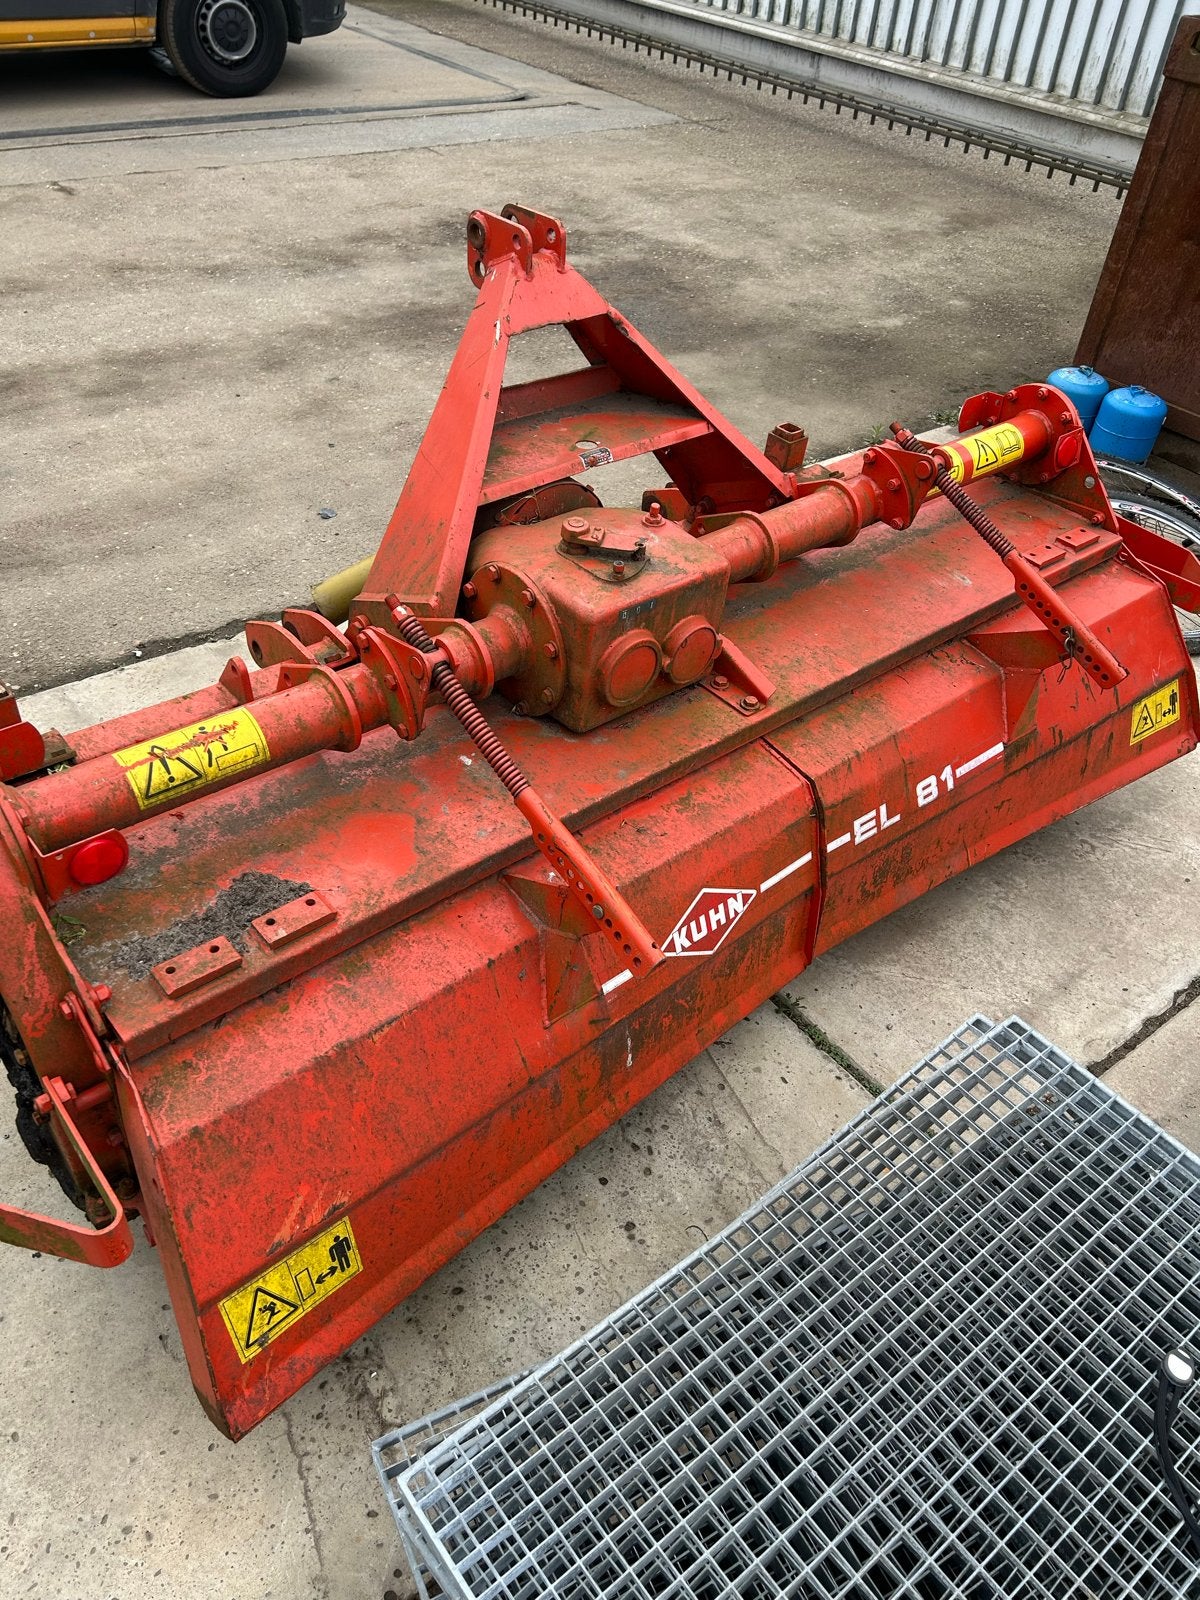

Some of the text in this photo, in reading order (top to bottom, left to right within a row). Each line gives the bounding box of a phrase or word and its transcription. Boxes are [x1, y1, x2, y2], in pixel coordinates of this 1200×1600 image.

[853, 764, 954, 846] EL 81
[672, 891, 744, 955] KUHN
